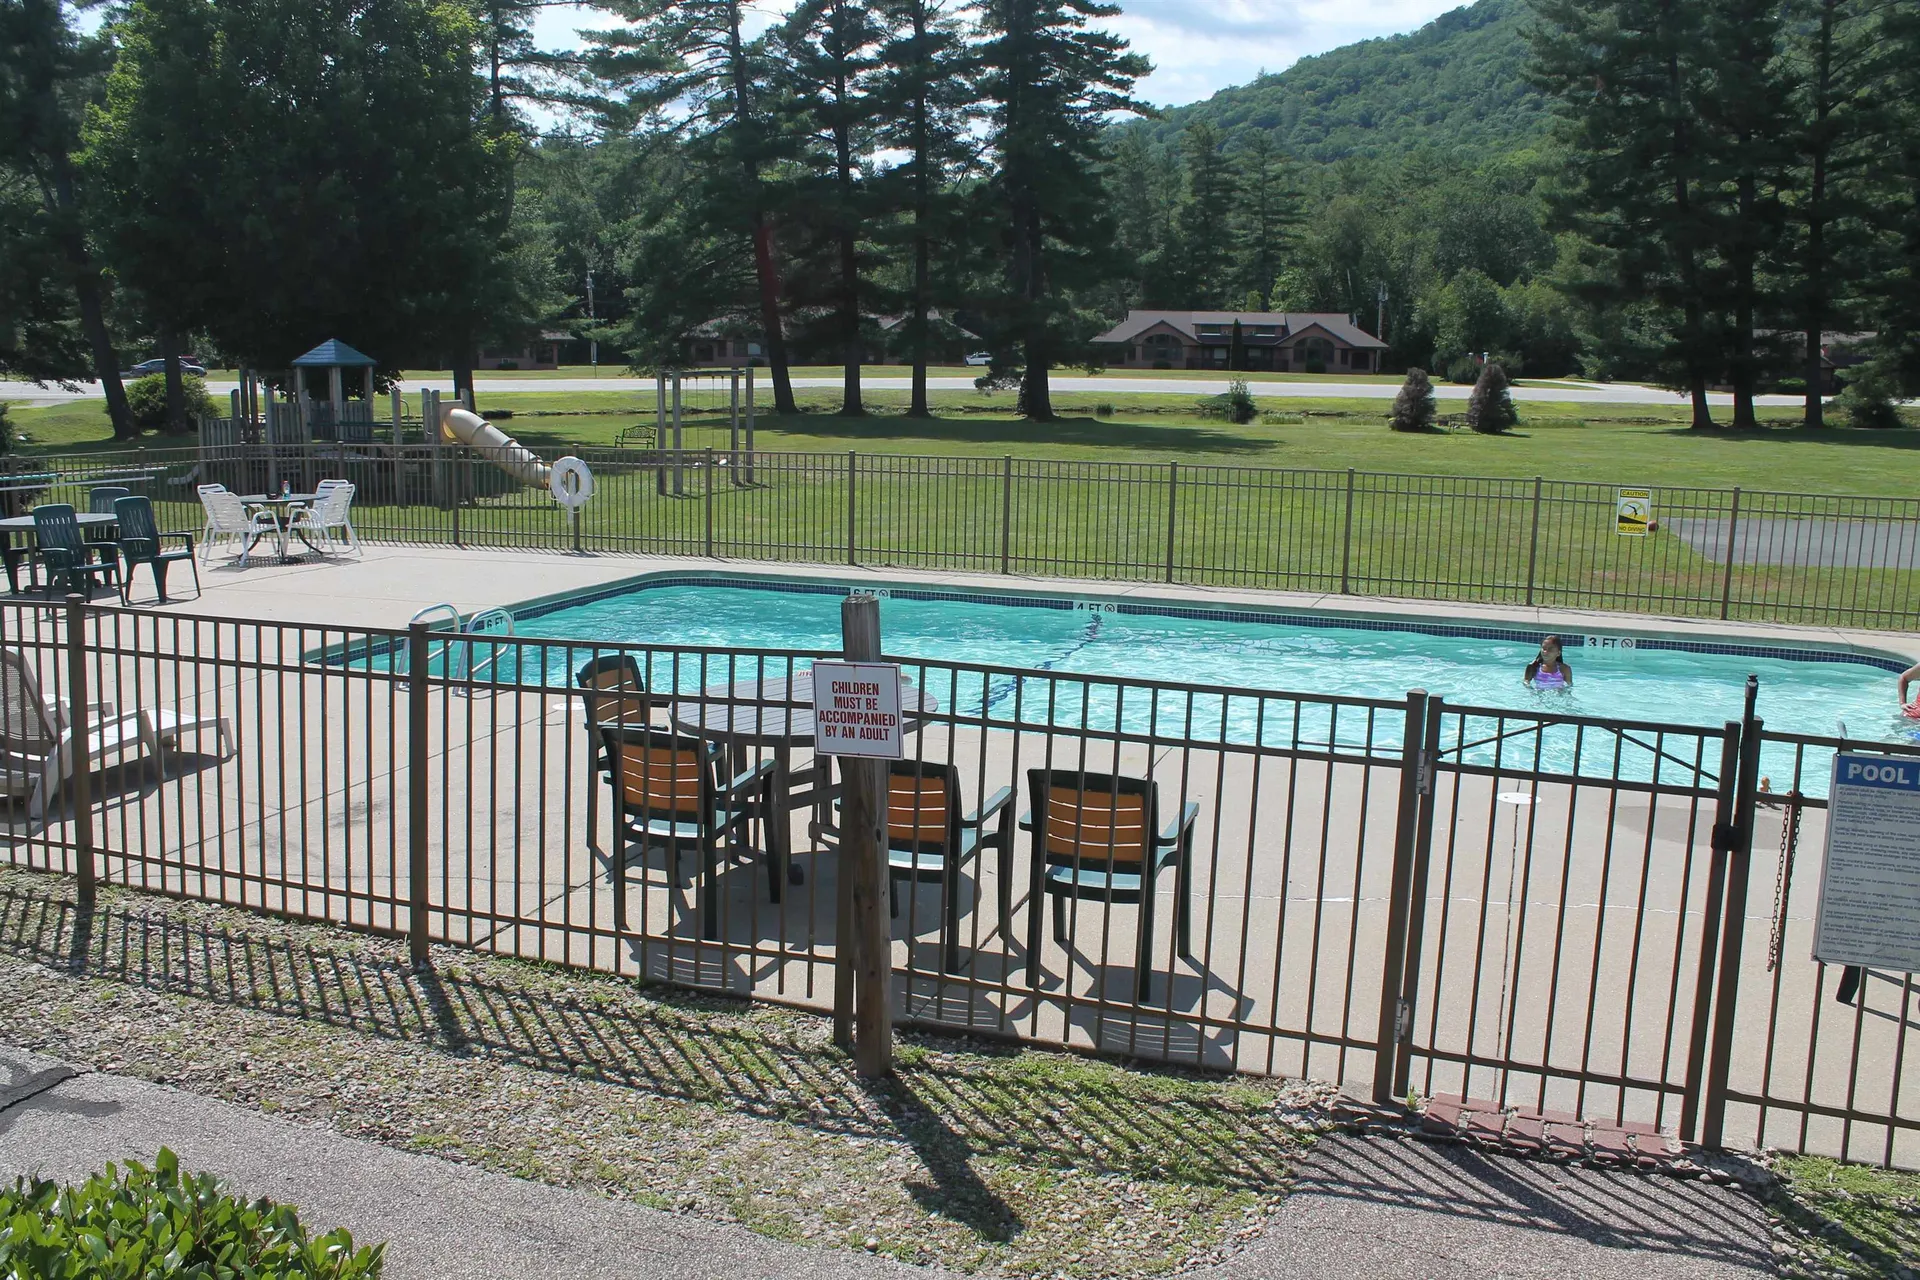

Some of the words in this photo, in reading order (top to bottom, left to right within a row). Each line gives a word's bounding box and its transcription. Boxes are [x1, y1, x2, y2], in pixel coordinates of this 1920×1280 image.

[1088, 603, 1102, 612] FT
[486, 619, 493, 629] 6
[495, 616, 503, 627] FT
[1588, 637, 1597, 647] 3
[1602, 638, 1617, 648] FT
[832, 681, 879, 696] CHILDREN
[834, 696, 862, 710] MUST
[866, 698, 878, 710] BE
[819, 710, 896, 727] ACCOMPANIED
[825, 725, 837, 738] BY
[841, 727, 855, 739] AN
[859, 728, 890, 741] ADULT
[1847, 763, 1910, 785] POOL
